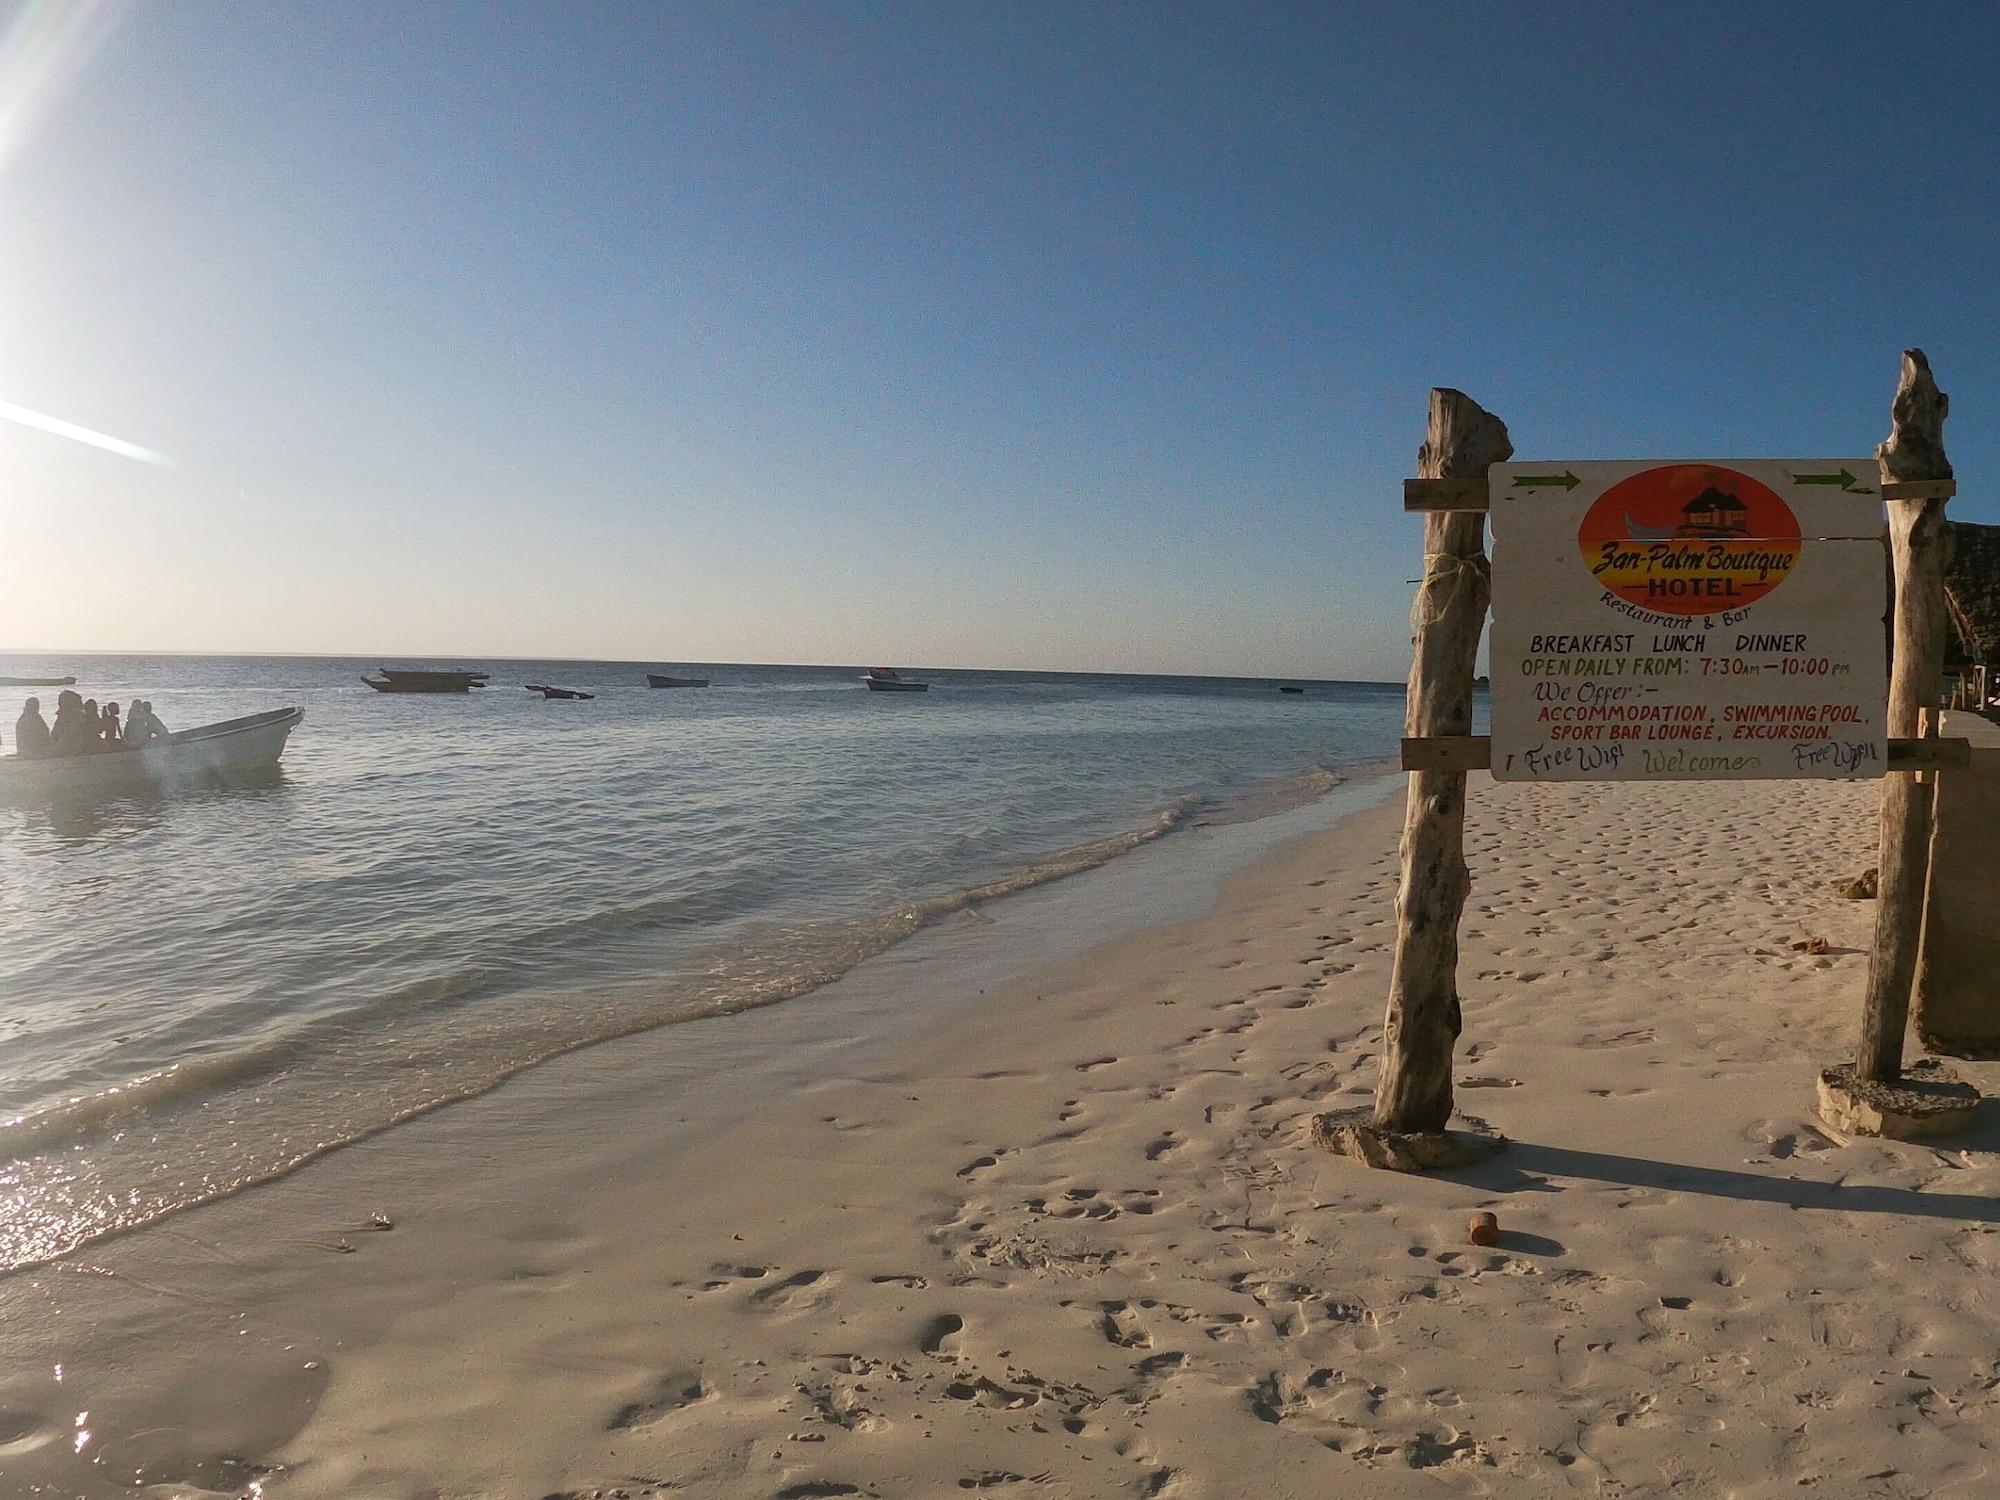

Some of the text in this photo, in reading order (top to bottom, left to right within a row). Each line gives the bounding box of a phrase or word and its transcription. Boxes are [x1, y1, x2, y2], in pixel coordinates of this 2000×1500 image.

[1706, 545, 1794, 581] Boutique
[1649, 578, 1742, 597] HOTEL
[1600, 592, 1694, 630] Restaurant
[1704, 616, 1715, 630] &
[1723, 607, 1752, 627] Bar
[1531, 634, 1808, 653] BREAKFAST LUNCH DINNER
[1522, 658, 1570, 676] OPEN
[1574, 658, 1626, 676] DAILY
[1632, 658, 1689, 676] FROM:
[1535, 682, 1570, 701] We
[1551, 725, 1605, 740] SPORT
[1609, 725, 1642, 740] BAR
[1524, 741, 1625, 775] Free Wifi
[1642, 749, 1760, 773] Welcome
[1791, 743, 1831, 770] Free
